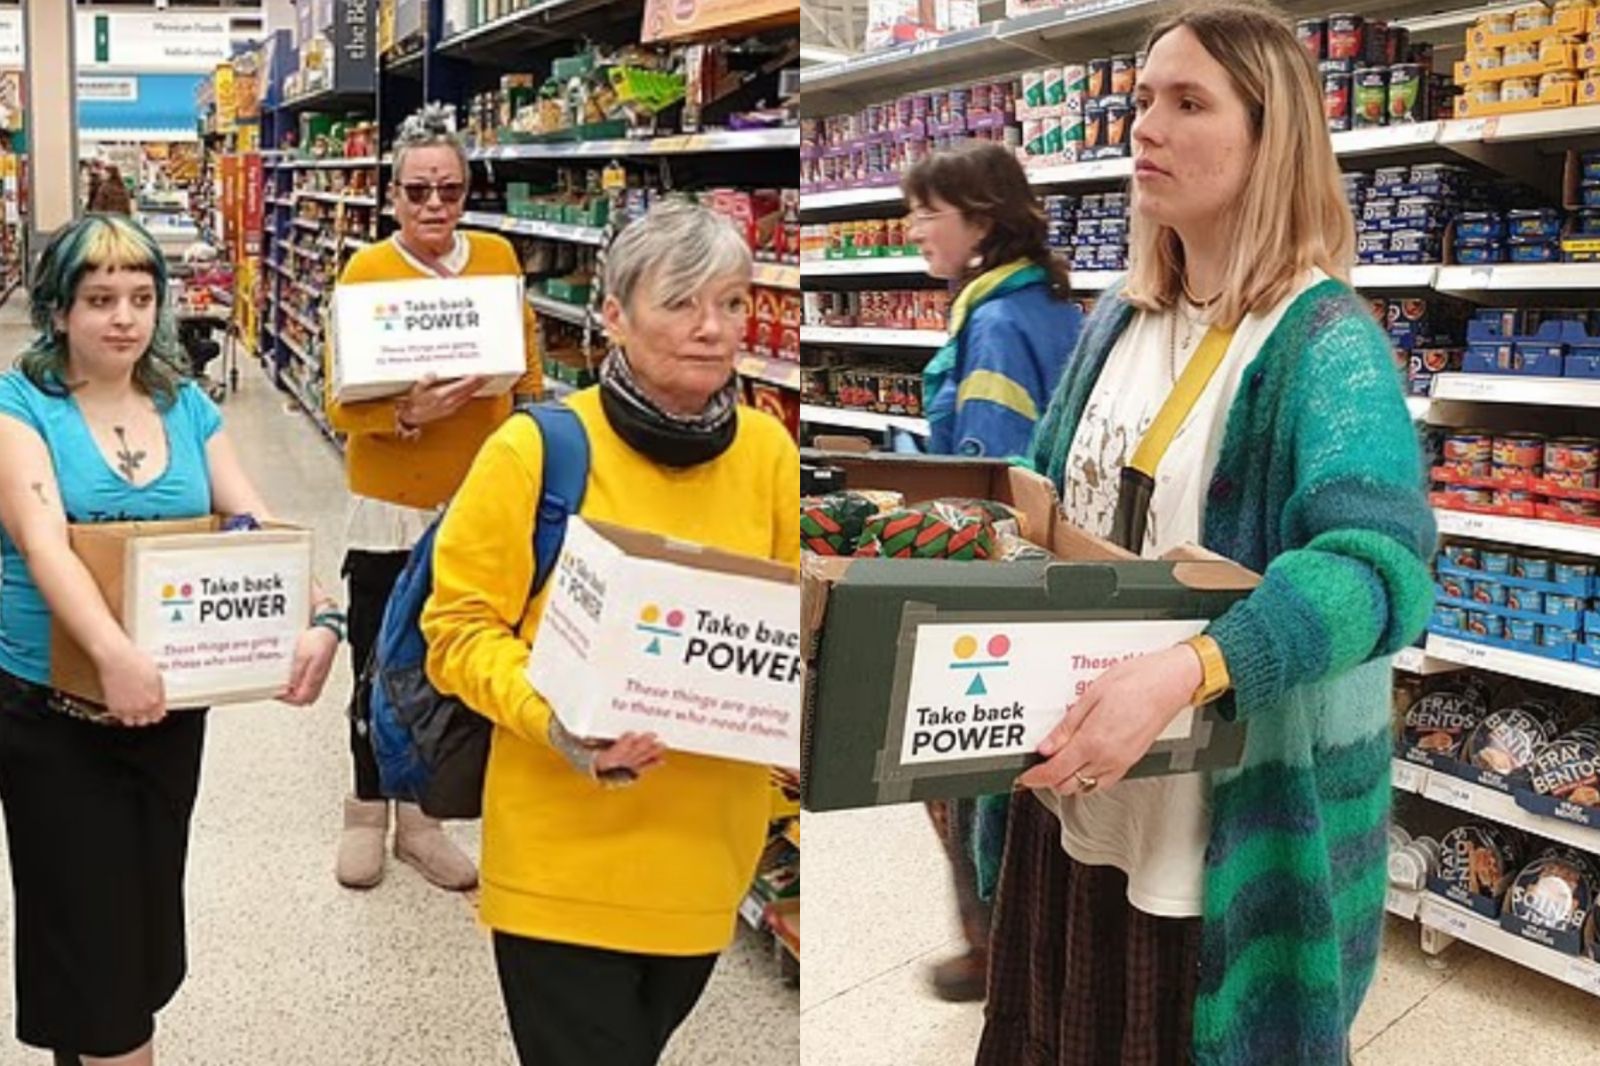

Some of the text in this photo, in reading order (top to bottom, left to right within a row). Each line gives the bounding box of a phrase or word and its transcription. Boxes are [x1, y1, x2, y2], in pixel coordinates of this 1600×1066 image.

[404, 298, 474, 312] Take back
[405, 311, 480, 330] POWER
[200, 572, 283, 595] Take back
[200, 594, 286, 622] POWER
[696, 610, 800, 648] Take bac
[625, 678, 790, 723] These things are going
[916, 701, 1024, 727] Take back
[1421, 697, 1463, 713] FRAY
[611, 698, 628, 711] to
[630, 700, 672, 718] those
[675, 709, 707, 723] who
[709, 717, 747, 732] need
[1406, 710, 1475, 729] BENTOS
[911, 723, 1026, 756] POWER
[1506, 710, 1549, 749] FRAY
[1537, 744, 1581, 772] FRAY
[1440, 843, 1457, 881] RAY
[1455, 828, 1471, 889] ENTOS
